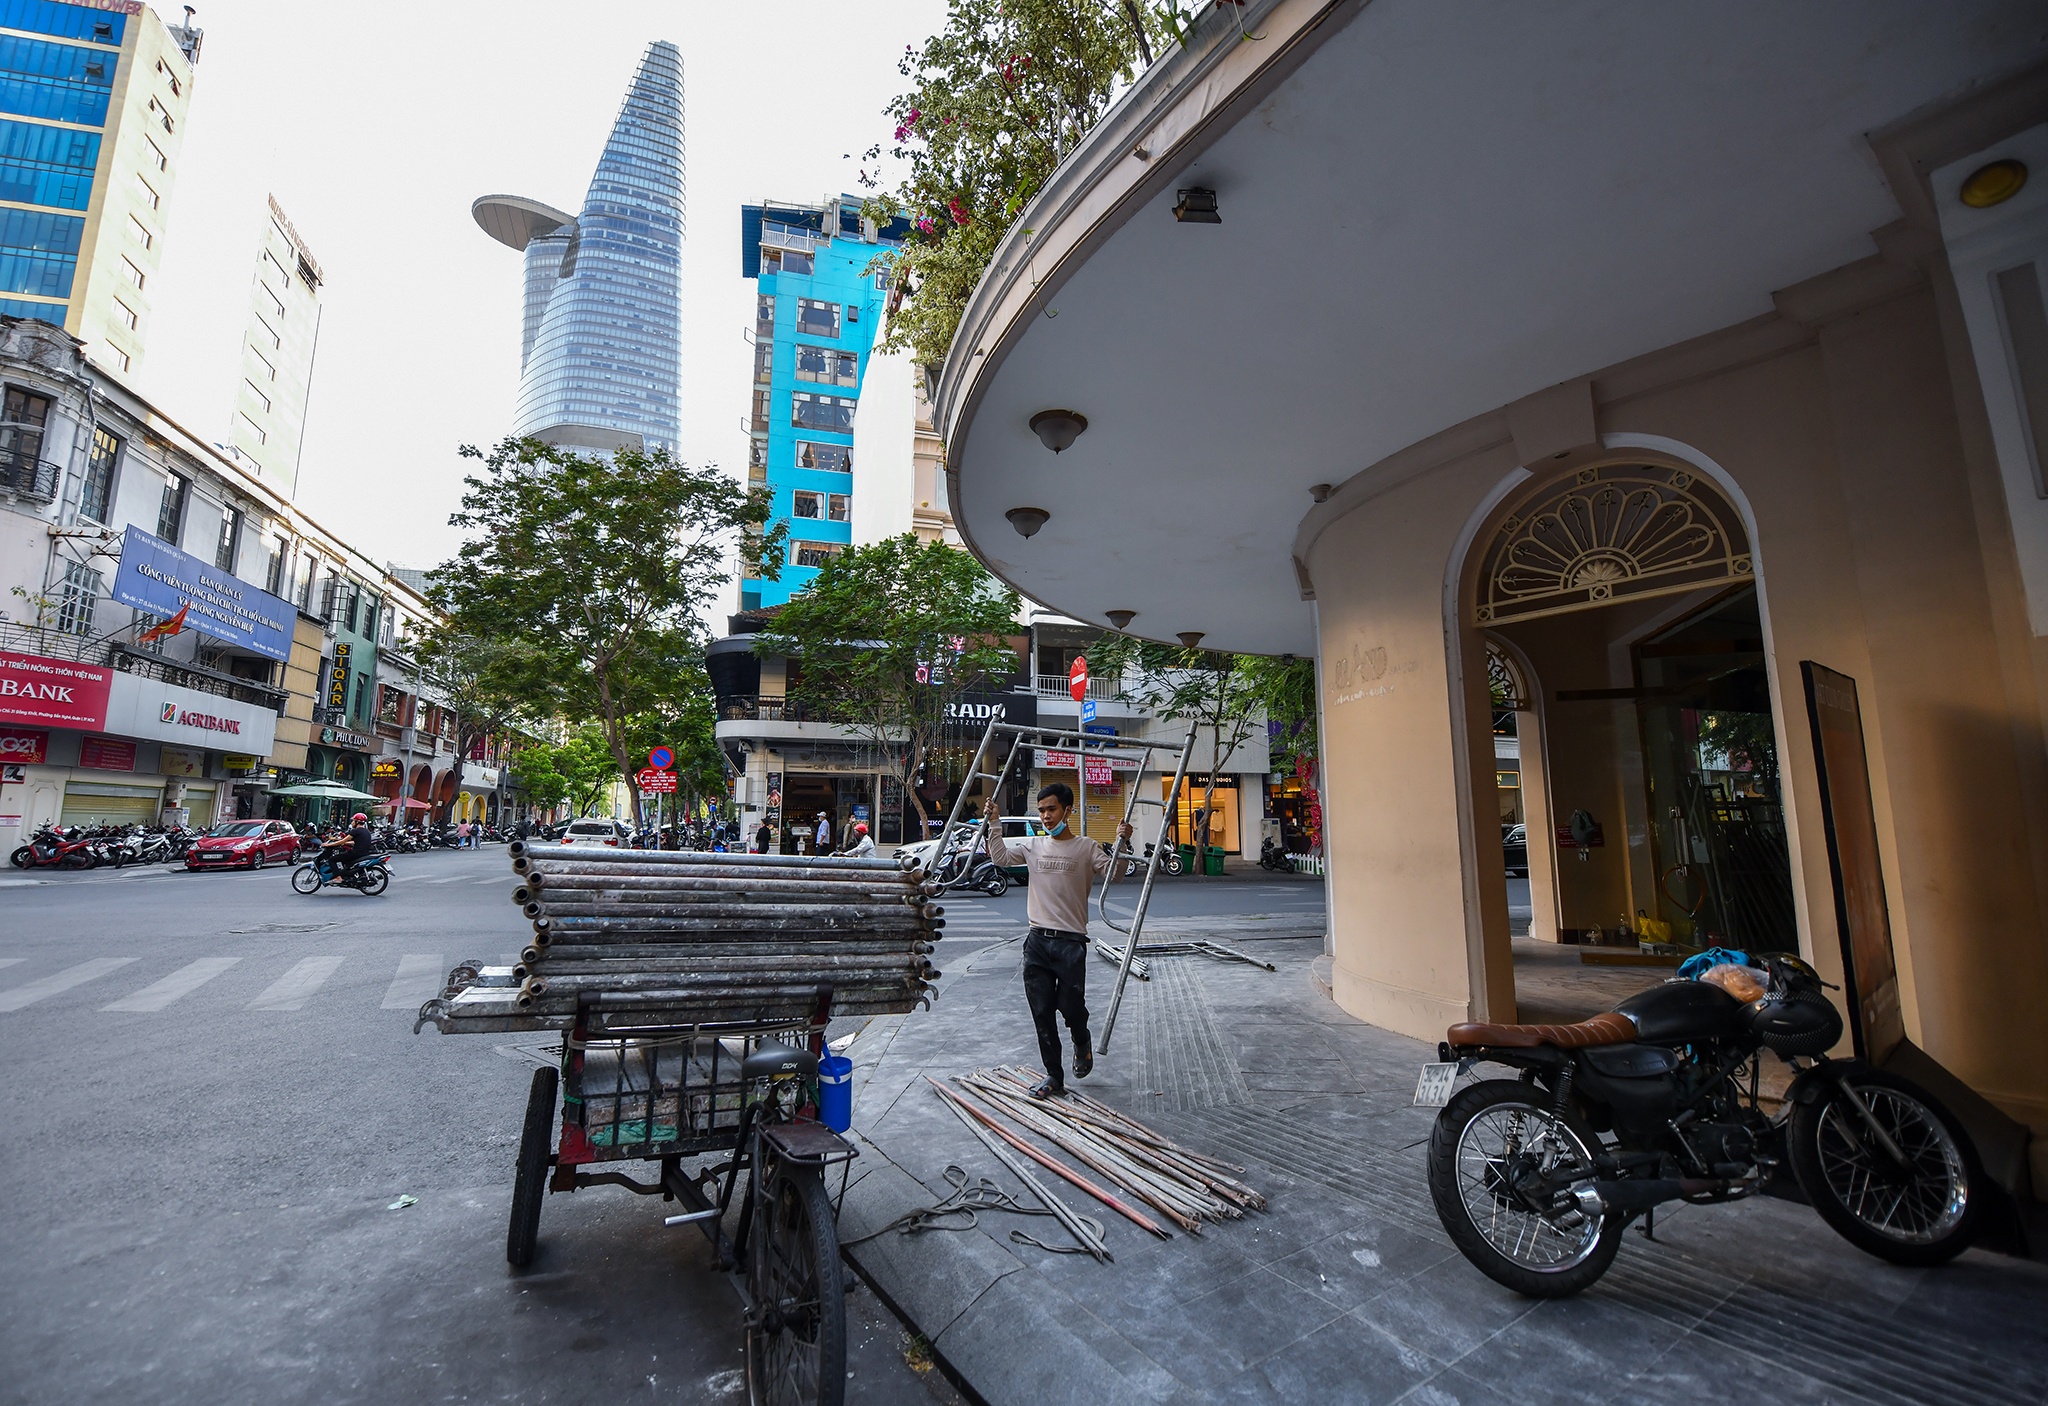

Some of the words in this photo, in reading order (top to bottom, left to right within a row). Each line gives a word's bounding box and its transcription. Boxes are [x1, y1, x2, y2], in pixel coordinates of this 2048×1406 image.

[137, 563, 161, 581] CÔNG
[161, 573, 181, 590] VIÊN
[200, 575, 214, 589] BAN
[8, 659, 29, 671] TRIỂN
[31, 664, 54, 675] NÔNG
[55, 668, 73, 677] THÔN
[74, 670, 88, 680] VIỆT
[88, 673, 103, 681] NAM
[331, 643, 348, 705] SIQAR
[0, 679, 74, 704] BANK
[177, 710, 241, 734] AGRIBANK
[943, 703, 1006, 719] RADO
[353, 735, 370, 747] LONG
